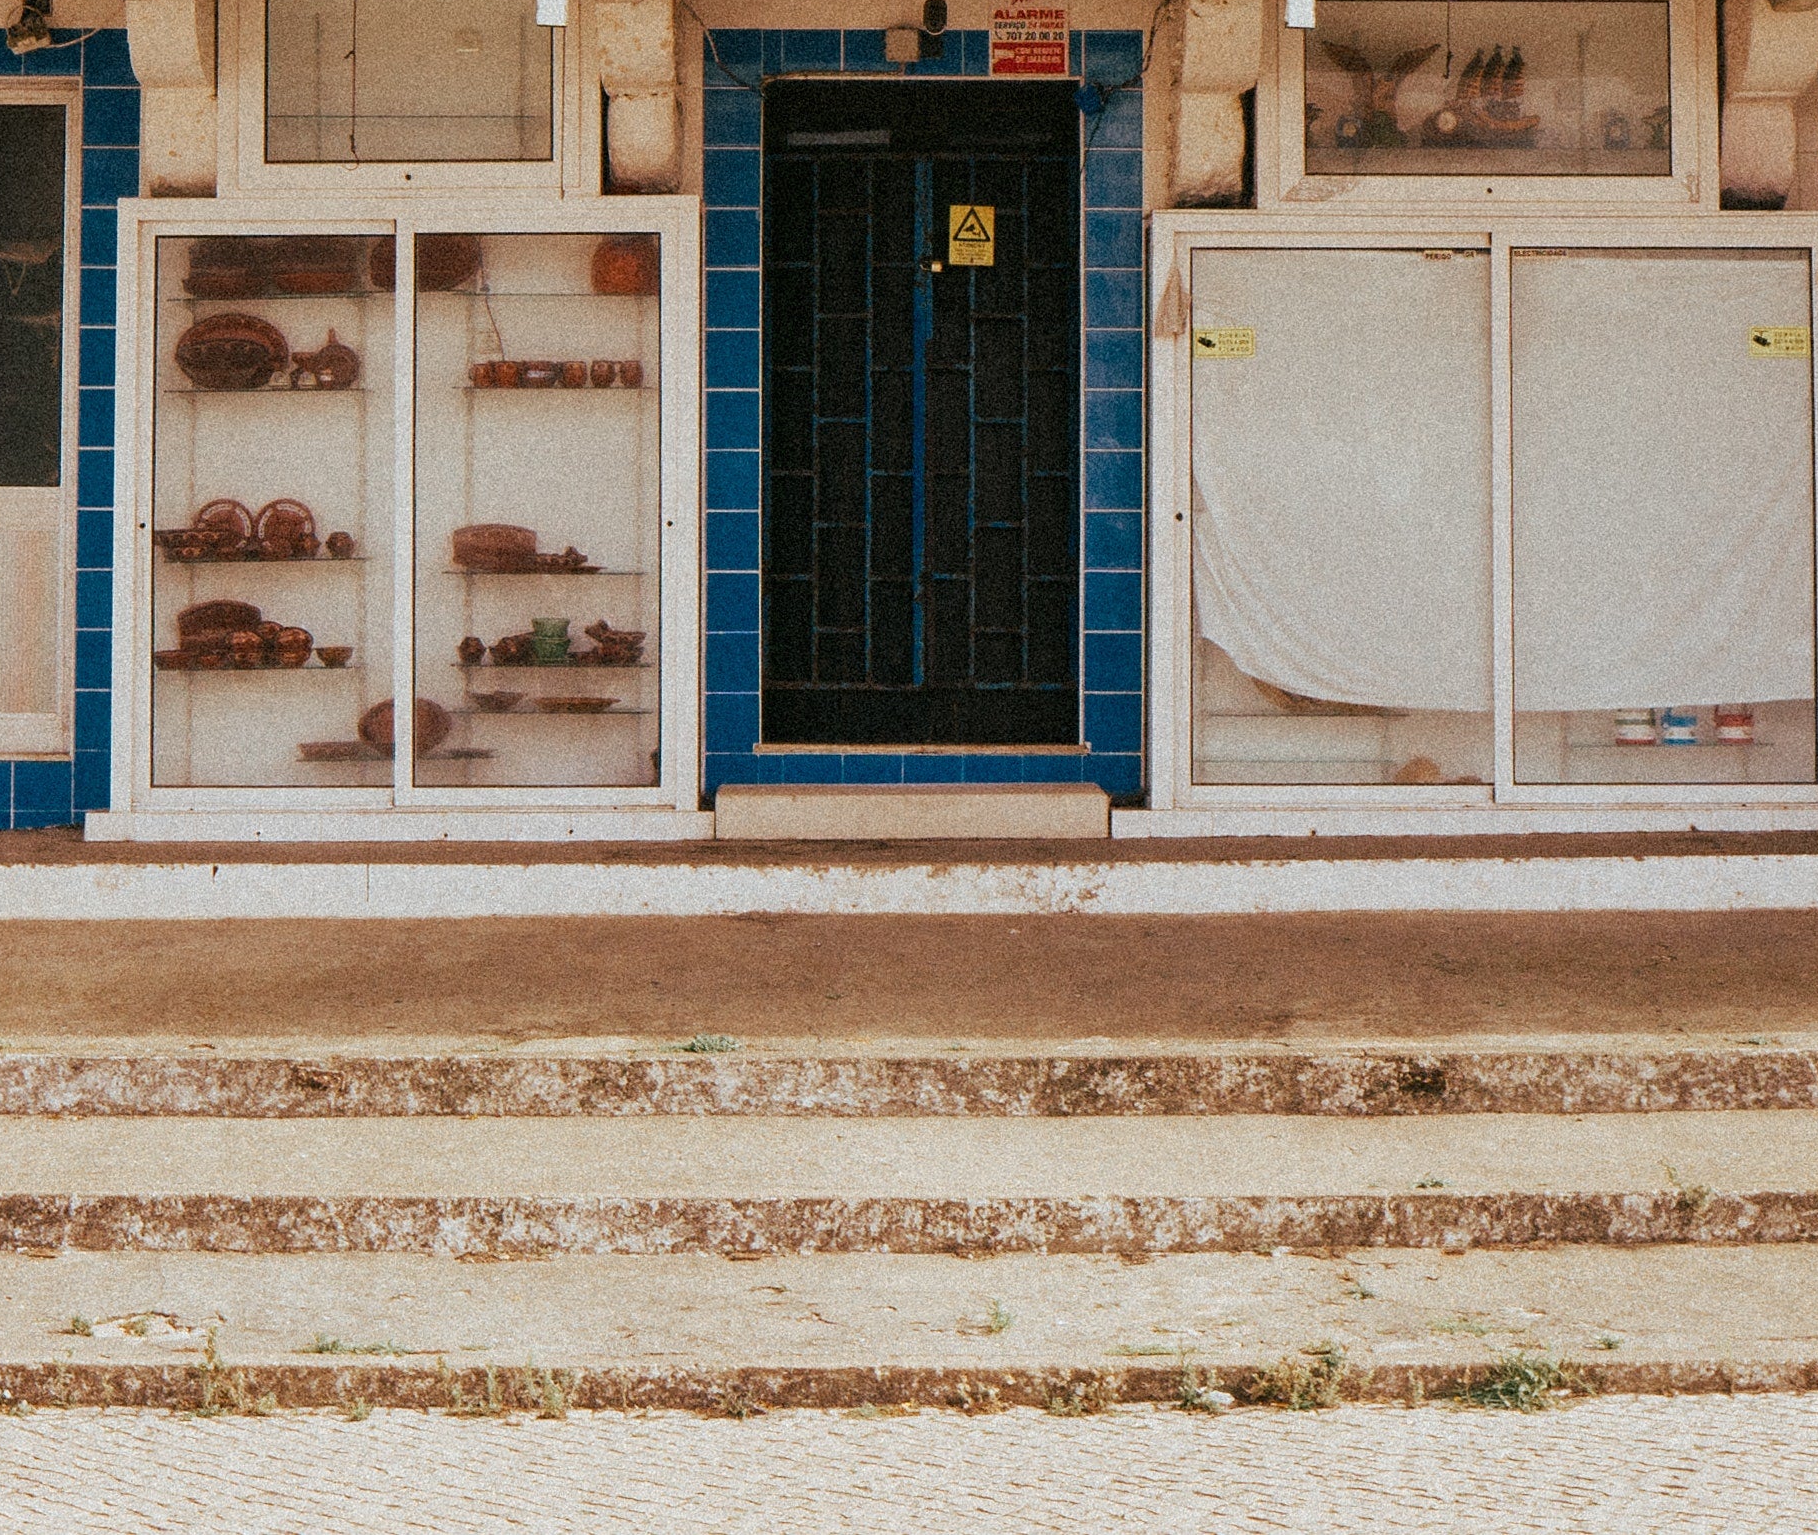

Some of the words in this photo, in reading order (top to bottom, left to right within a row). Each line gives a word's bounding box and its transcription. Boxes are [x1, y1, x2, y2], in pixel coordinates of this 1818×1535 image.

[993, 9, 1066, 20] ALARME
[1025, 31, 1037, 41] 20
[1053, 31, 1065, 41] 20
